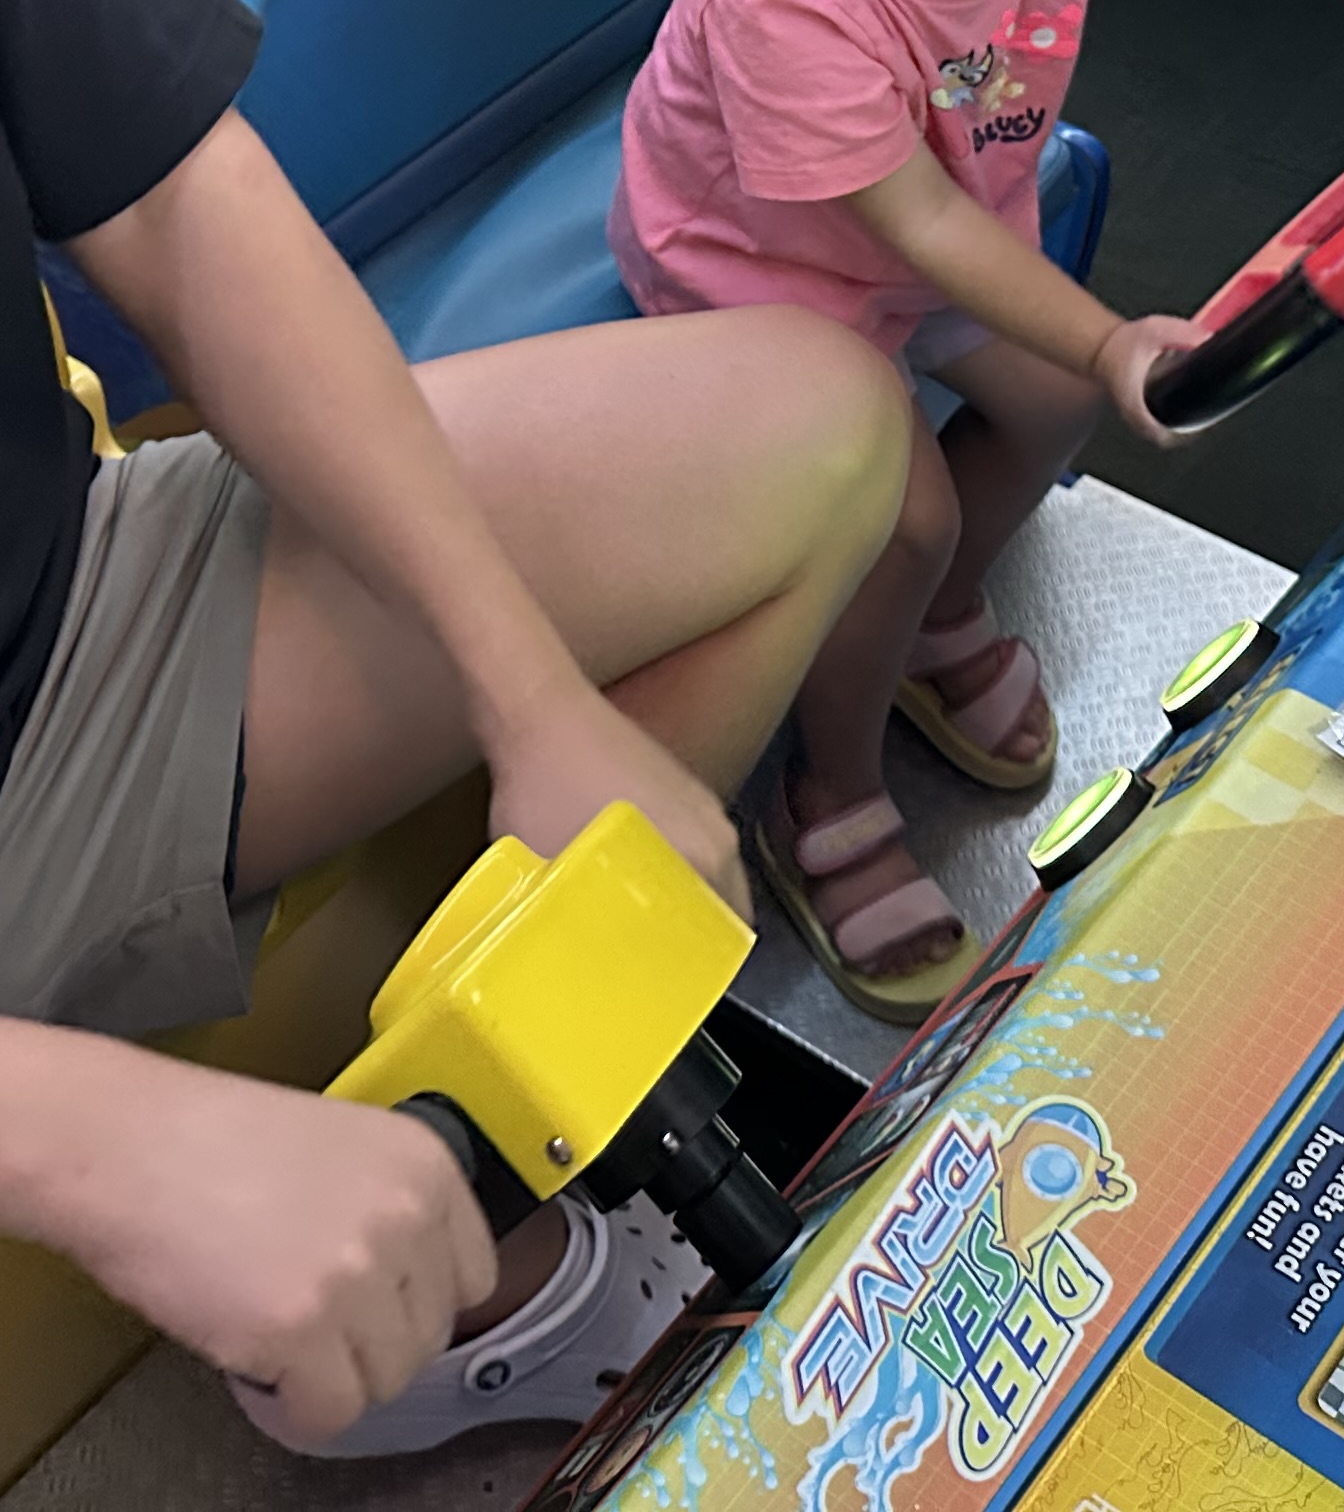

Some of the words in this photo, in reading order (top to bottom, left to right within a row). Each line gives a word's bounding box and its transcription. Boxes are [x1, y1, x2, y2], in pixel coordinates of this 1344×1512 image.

[1283, 1124, 1344, 1193] have
[1245, 1188, 1300, 1249] fun!
[1272, 1220, 1324, 1281] and
[793, 1121, 998, 1421] DRIVE
[897, 1211, 1027, 1387] SEA
[1287, 1261, 1340, 1331] your
[957, 1229, 1106, 1472] DEEP
